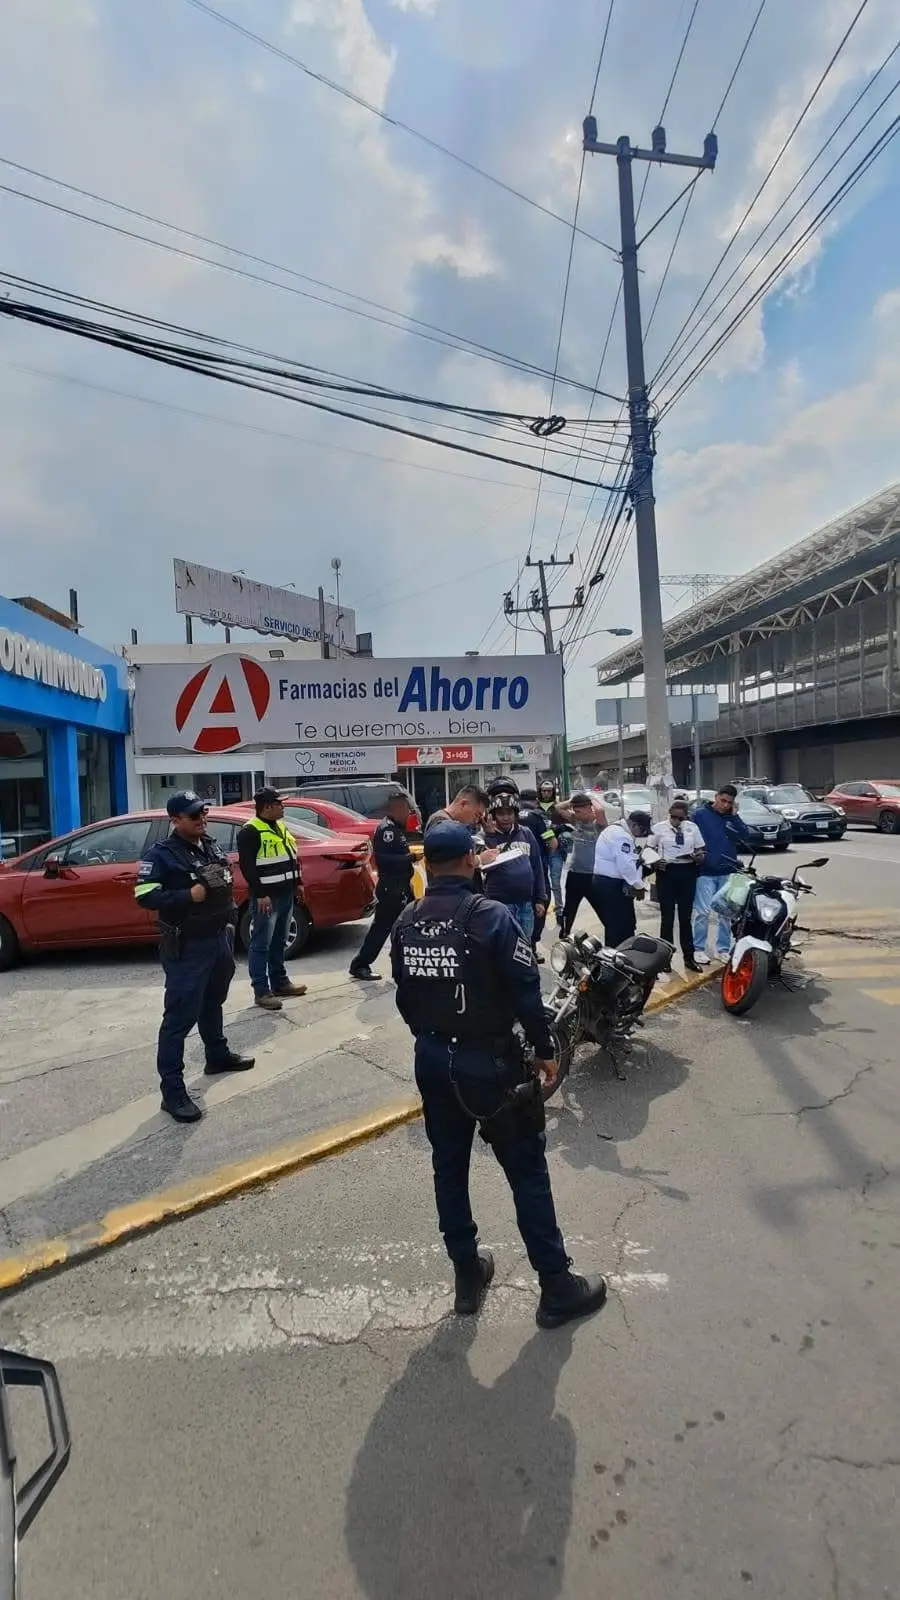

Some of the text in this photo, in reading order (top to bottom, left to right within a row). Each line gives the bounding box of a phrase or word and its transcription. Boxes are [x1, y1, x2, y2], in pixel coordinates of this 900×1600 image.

[263, 616, 301, 635] SERVICIO
[279, 665, 529, 713] Farmacias del Ahorro
[175, 654, 268, 752] A
[295, 722, 318, 739] Te
[324, 722, 441, 741] queremos...
[403, 945, 457, 957] POLICÍA
[404, 956, 459, 967] ESTATAL
[409, 967, 455, 977] FAR II
